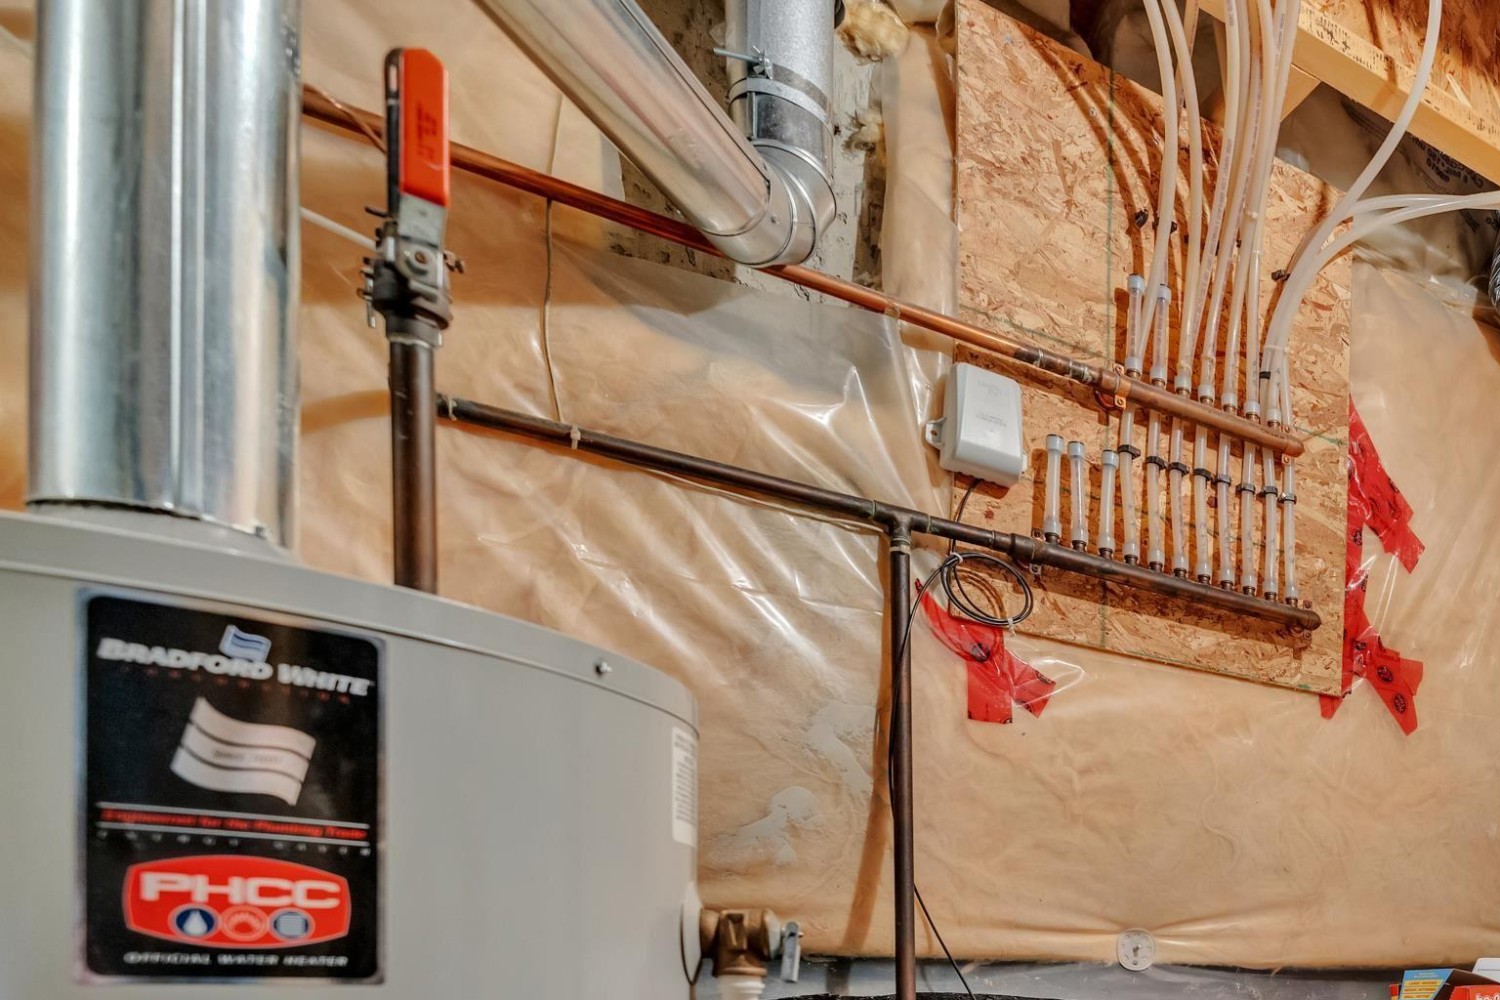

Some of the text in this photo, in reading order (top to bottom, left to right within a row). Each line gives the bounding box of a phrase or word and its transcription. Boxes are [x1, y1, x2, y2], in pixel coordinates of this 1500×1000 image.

[97, 637, 273, 680] BRADFORD
[277, 663, 370, 697] WHITE
[140, 871, 341, 909] PHCC
